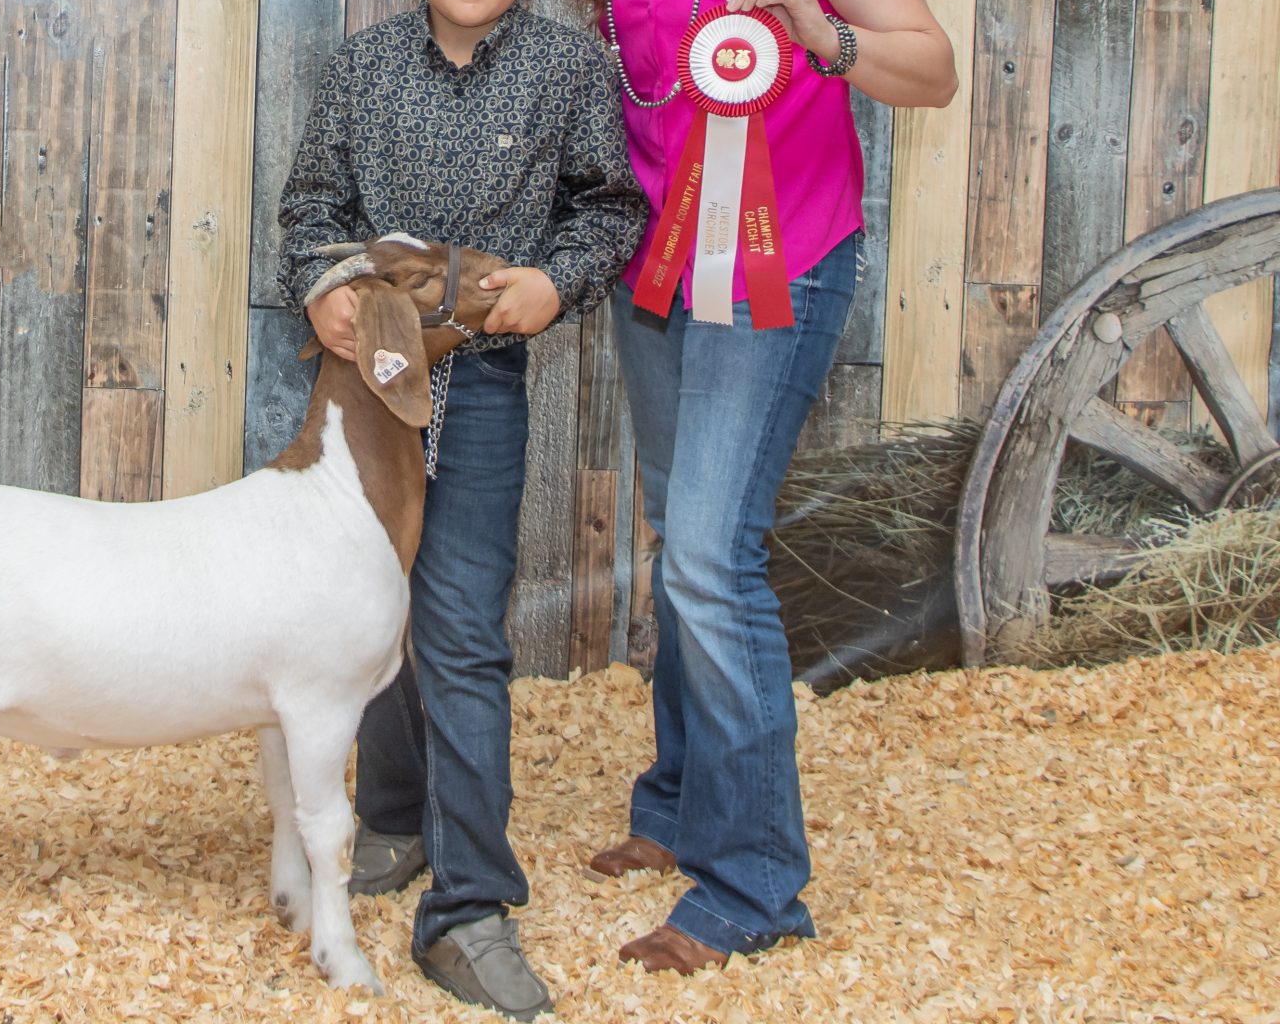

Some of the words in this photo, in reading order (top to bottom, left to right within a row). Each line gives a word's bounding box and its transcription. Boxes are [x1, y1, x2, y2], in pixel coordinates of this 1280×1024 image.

[652, 263, 668, 287] 2025
[662, 223, 682, 262] MORGAN
[677, 185, 695, 221] COUNTY
[688, 162, 703, 183] FAIR
[704, 201, 717, 256] PURCHASER
[718, 205, 730, 255] LIVESTOCK
[744, 210, 761, 253] CATCH-IT
[758, 206, 775, 255] CHAMPION
